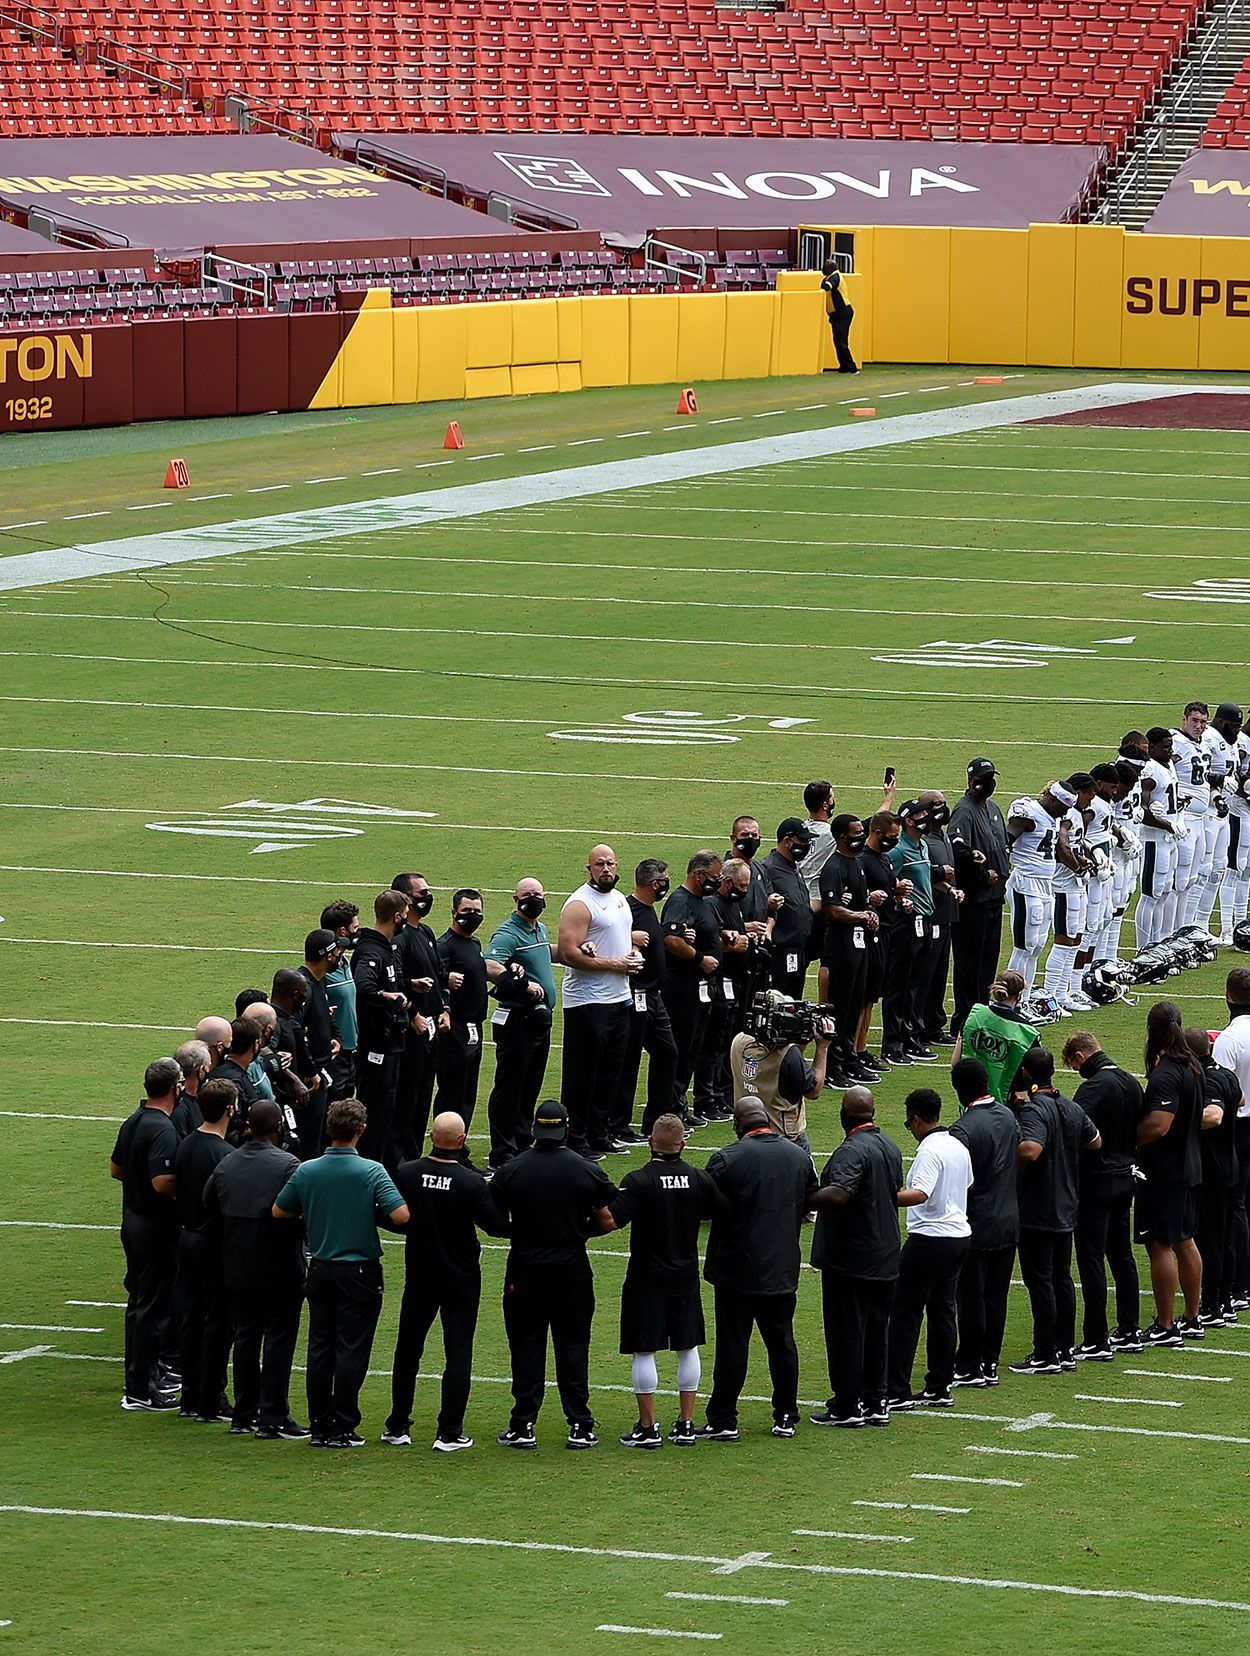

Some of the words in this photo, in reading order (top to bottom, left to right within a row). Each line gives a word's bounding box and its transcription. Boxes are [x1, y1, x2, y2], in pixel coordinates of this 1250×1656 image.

[0, 167, 389, 194] WASHINGTON
[616, 167, 980, 201] INOVA
[68, 193, 199, 206] FOOTBALL
[198, 189, 276, 203] TEAM,
[271, 189, 322, 201] EST.
[325, 187, 379, 199] 1932
[5, 396, 52, 421] 1932
[686, 390, 697, 412] G
[173, 461, 188, 485] 20
[1165, 783, 1179, 815] 1
[1037, 829, 1058, 860] 4
[422, 1173, 453, 1191] TEAM
[659, 1175, 690, 1189] TEAM
